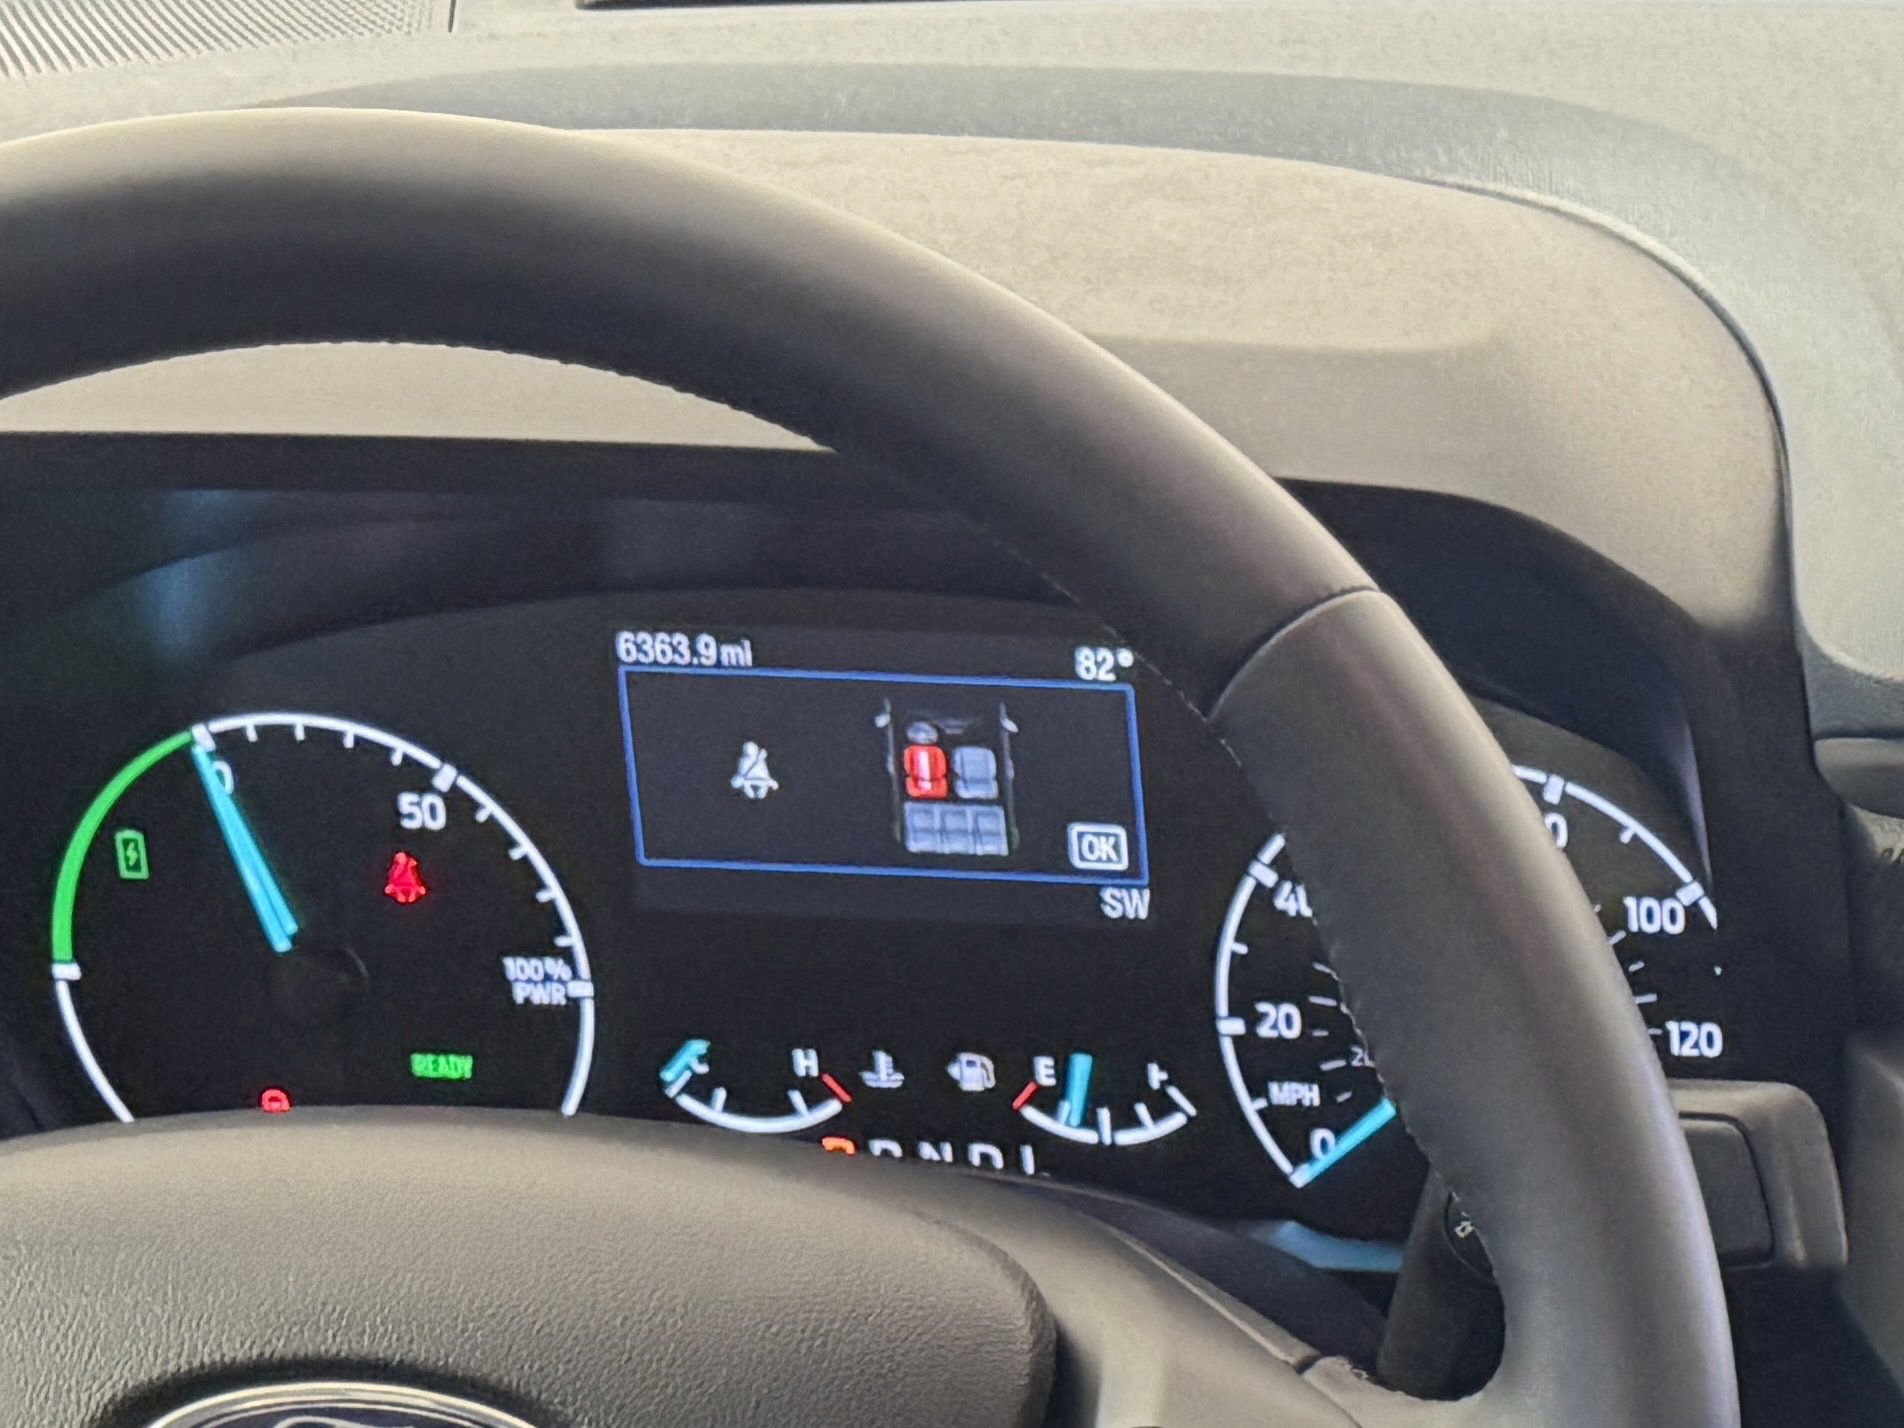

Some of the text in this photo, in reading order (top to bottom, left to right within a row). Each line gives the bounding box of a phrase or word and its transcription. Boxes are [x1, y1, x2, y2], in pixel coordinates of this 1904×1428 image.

[616, 630, 717, 667] 6363.9
[1074, 646, 1134, 682] 82°
[397, 791, 447, 831] 50
[1081, 833, 1119, 861] OK
[1101, 886, 1150, 920] SW
[1623, 896, 1686, 935] 100
[503, 957, 572, 981] 100%
[511, 981, 568, 1005] PWR
[1254, 1002, 1302, 1039] 20
[1664, 1020, 1724, 1059] 120
[411, 1053, 473, 1080] READY
[791, 1048, 819, 1077] H
[1033, 1055, 1057, 1086] E
[1267, 1081, 1321, 1107] MPH
[1309, 1127, 1337, 1161] 0
